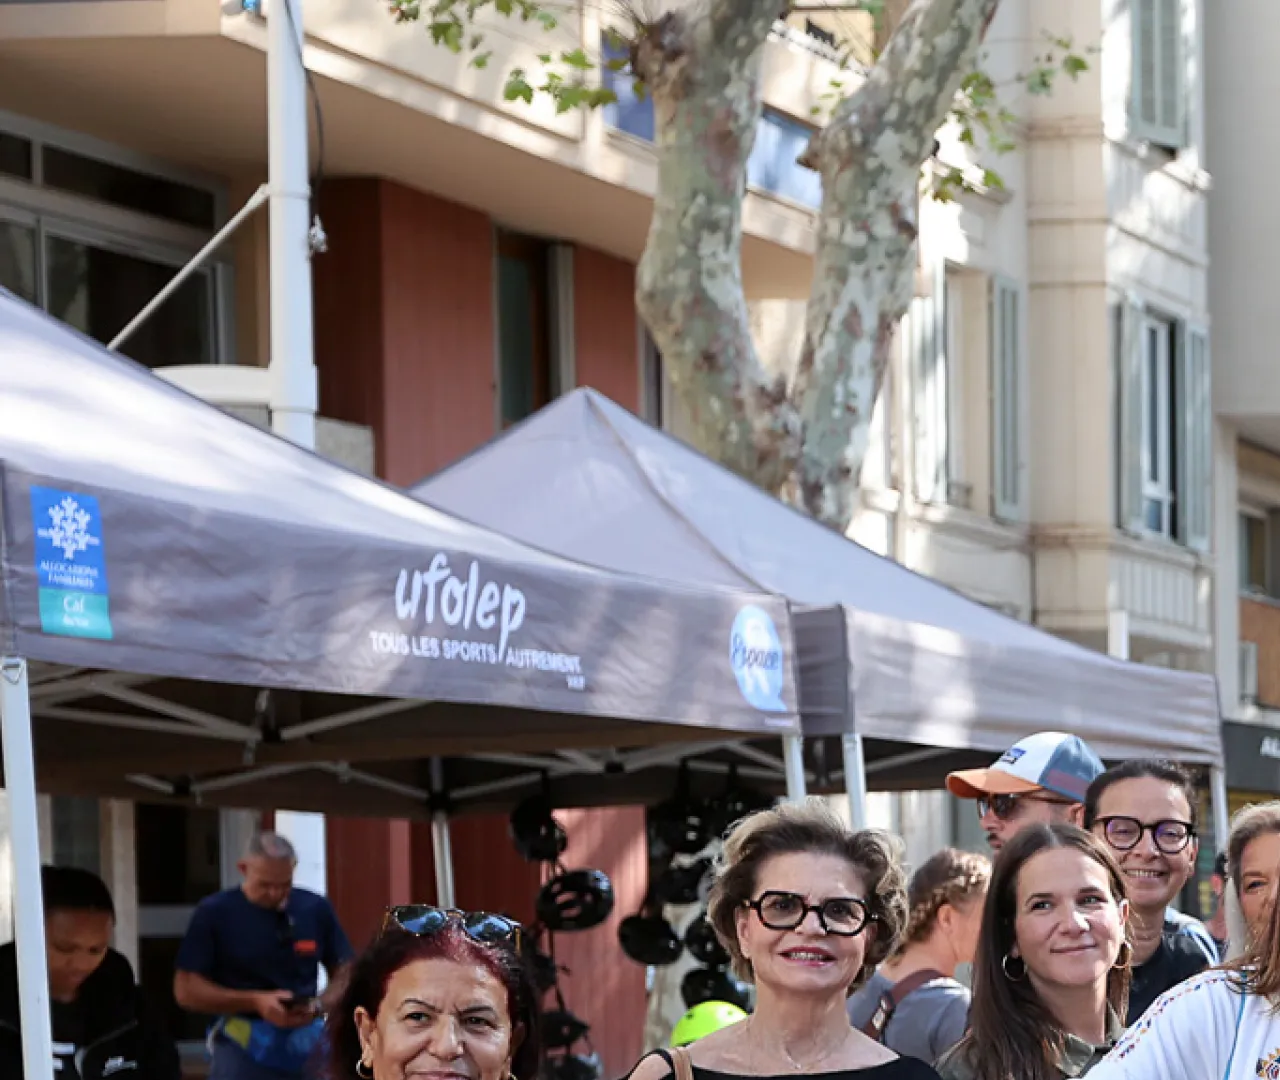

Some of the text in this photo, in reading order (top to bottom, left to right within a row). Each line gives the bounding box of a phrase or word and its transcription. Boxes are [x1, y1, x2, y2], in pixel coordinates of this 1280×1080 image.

[395, 552, 527, 662] ufolep
[369, 629, 582, 673] TOUS LES SPORTS AUTREMENT
